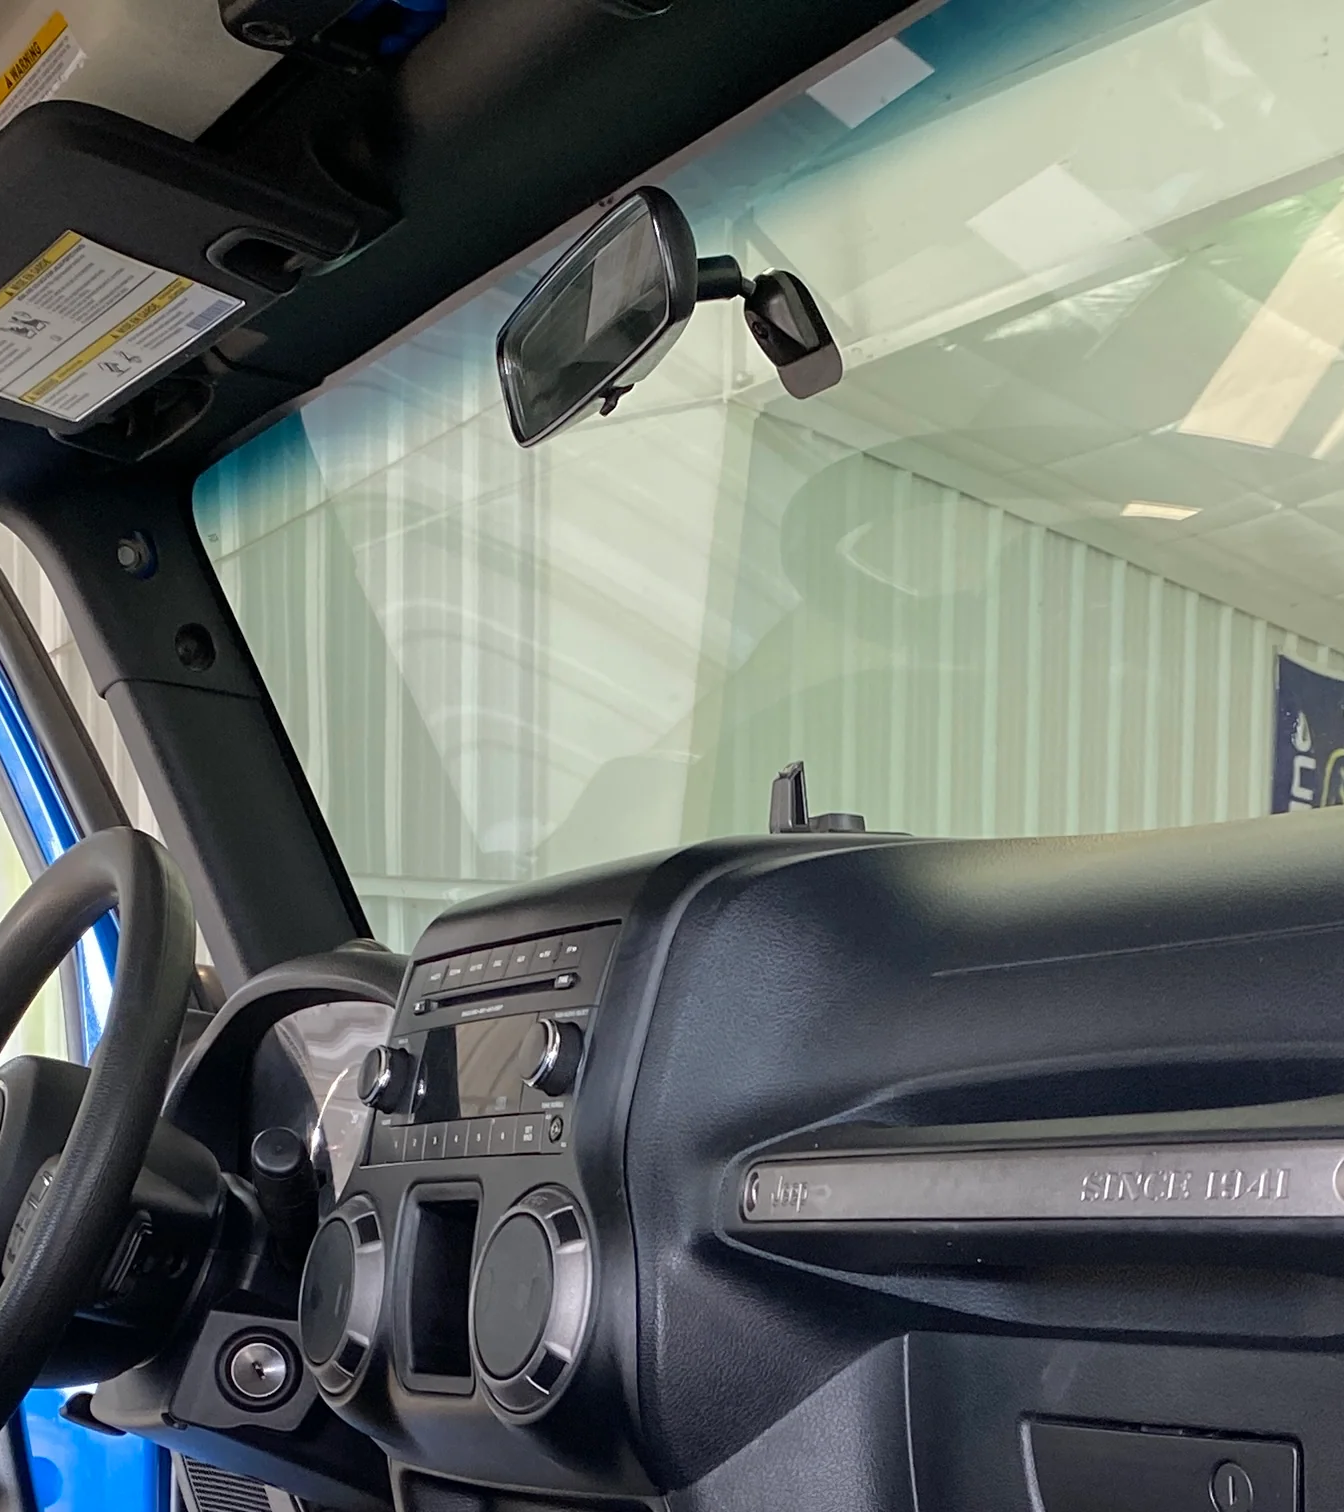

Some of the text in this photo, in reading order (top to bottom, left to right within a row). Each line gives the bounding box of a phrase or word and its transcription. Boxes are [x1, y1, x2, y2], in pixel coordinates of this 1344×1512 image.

[9, 41, 42, 80] WARNING
[770, 1168, 1291, 1214] Jeep SINCE 1941
